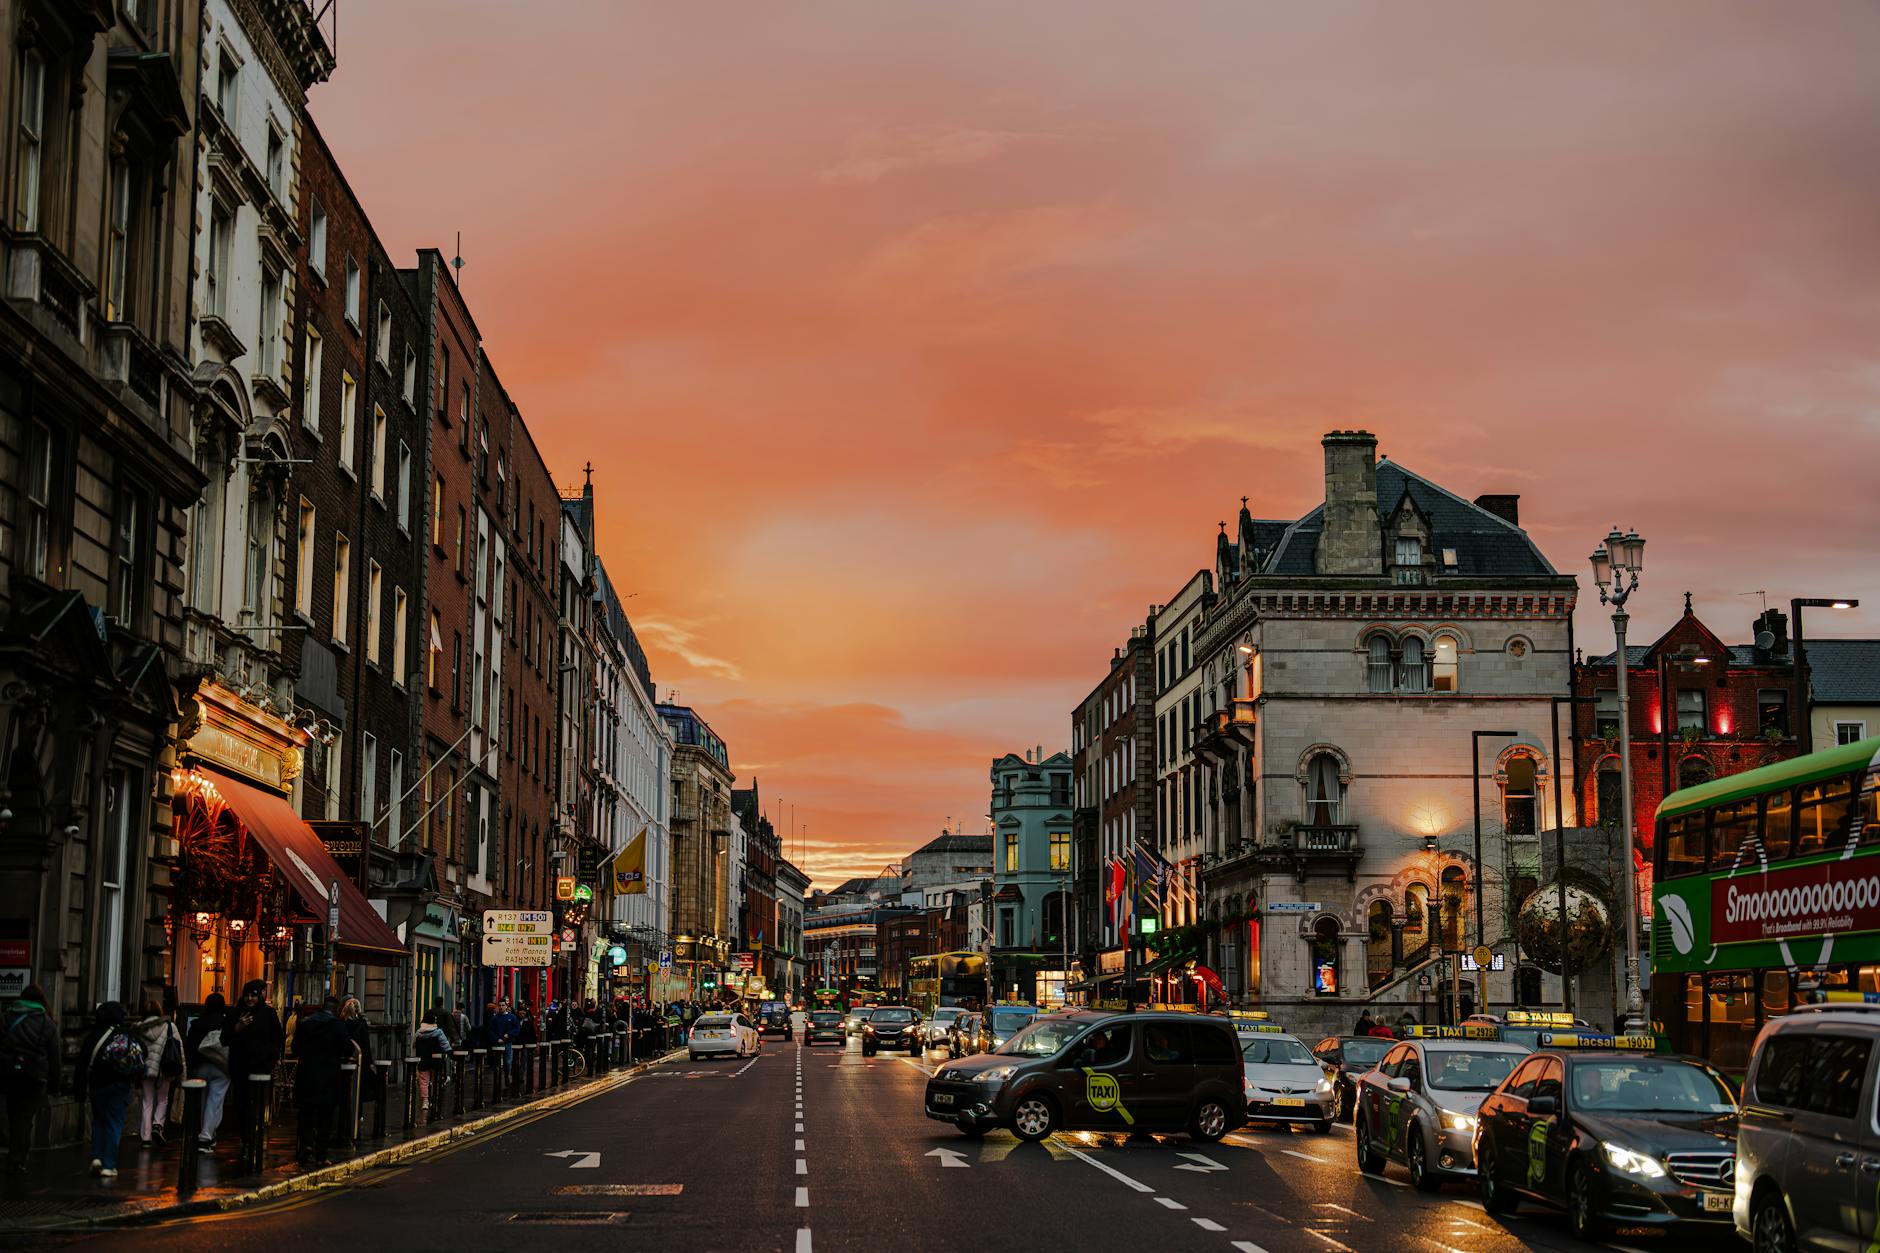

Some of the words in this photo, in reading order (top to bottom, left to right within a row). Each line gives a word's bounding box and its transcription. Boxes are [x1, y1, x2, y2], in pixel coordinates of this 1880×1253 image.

[1775, 919, 1802, 933] Broadband
[1802, 918, 1813, 931] with
[1828, 914, 1854, 930] Reliability
[1530, 1012, 1552, 1022] TAXI
[1239, 1024, 1258, 1032] TAXI
[1441, 1027, 1463, 1037] TAXI
[1579, 1035, 1615, 1047] tacsai
[1626, 1036, 1652, 1048] 19037
[1091, 1086, 1114, 1098] TAXI
